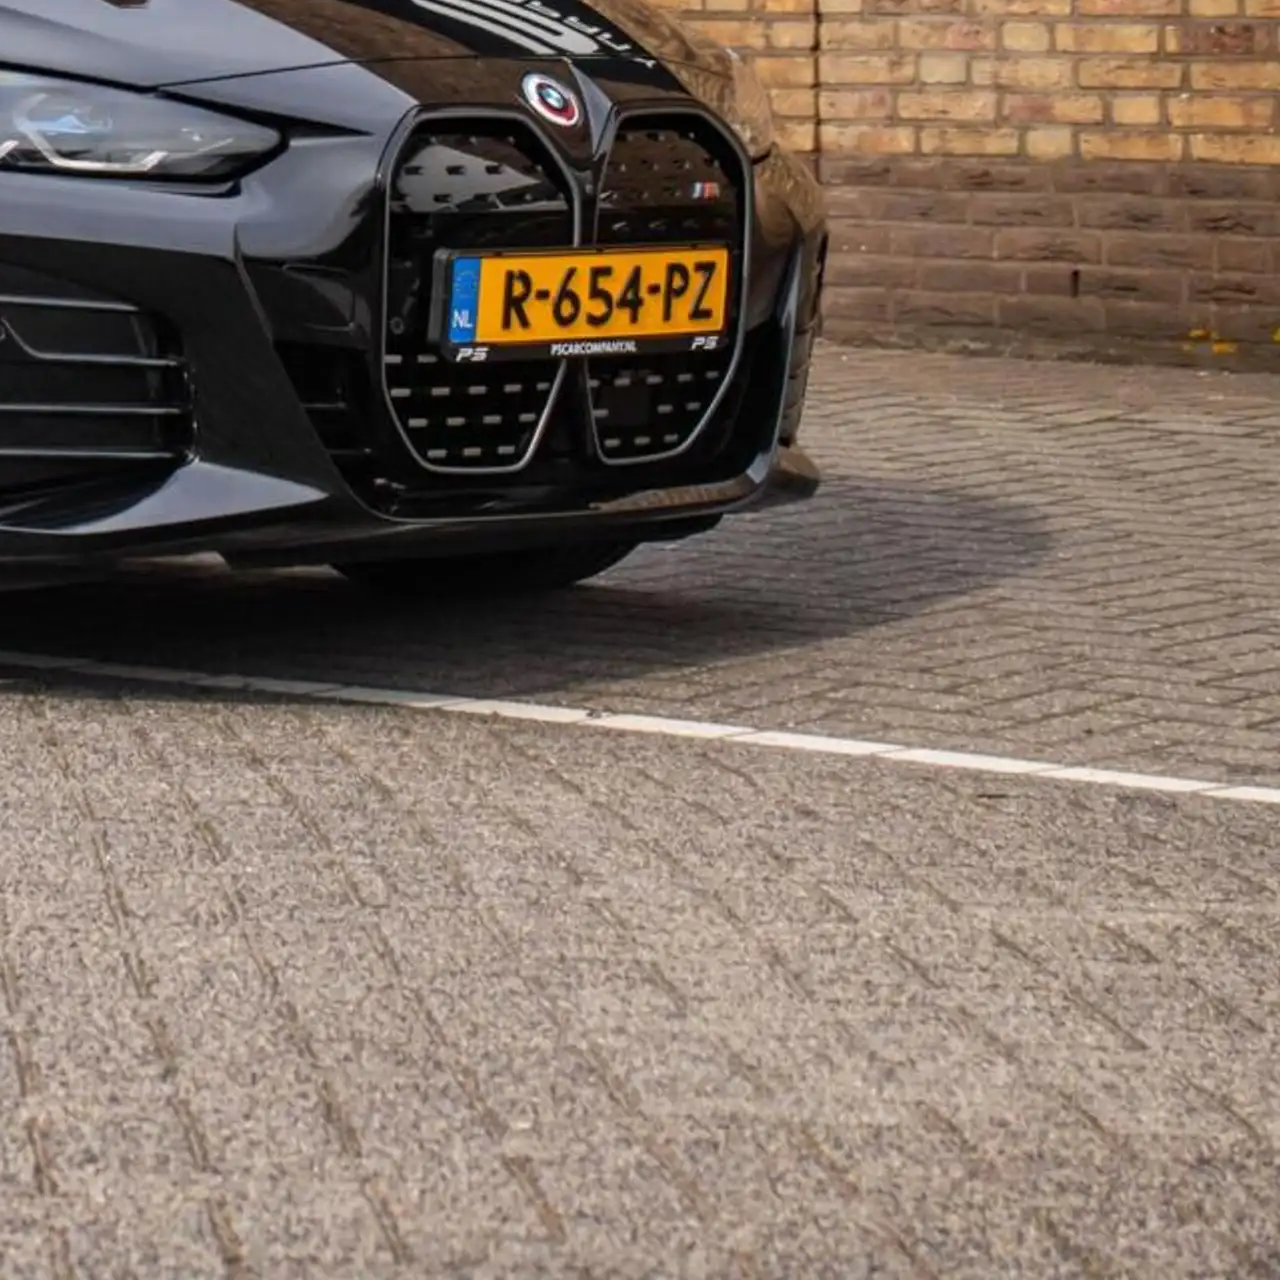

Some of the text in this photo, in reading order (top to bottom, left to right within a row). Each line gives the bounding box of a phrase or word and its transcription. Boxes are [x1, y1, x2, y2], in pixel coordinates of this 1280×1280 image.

[502, 261, 717, 330] R-654-PZ
[452, 308, 473, 329] NL
[691, 336, 719, 350] PS
[456, 347, 489, 362] PS
